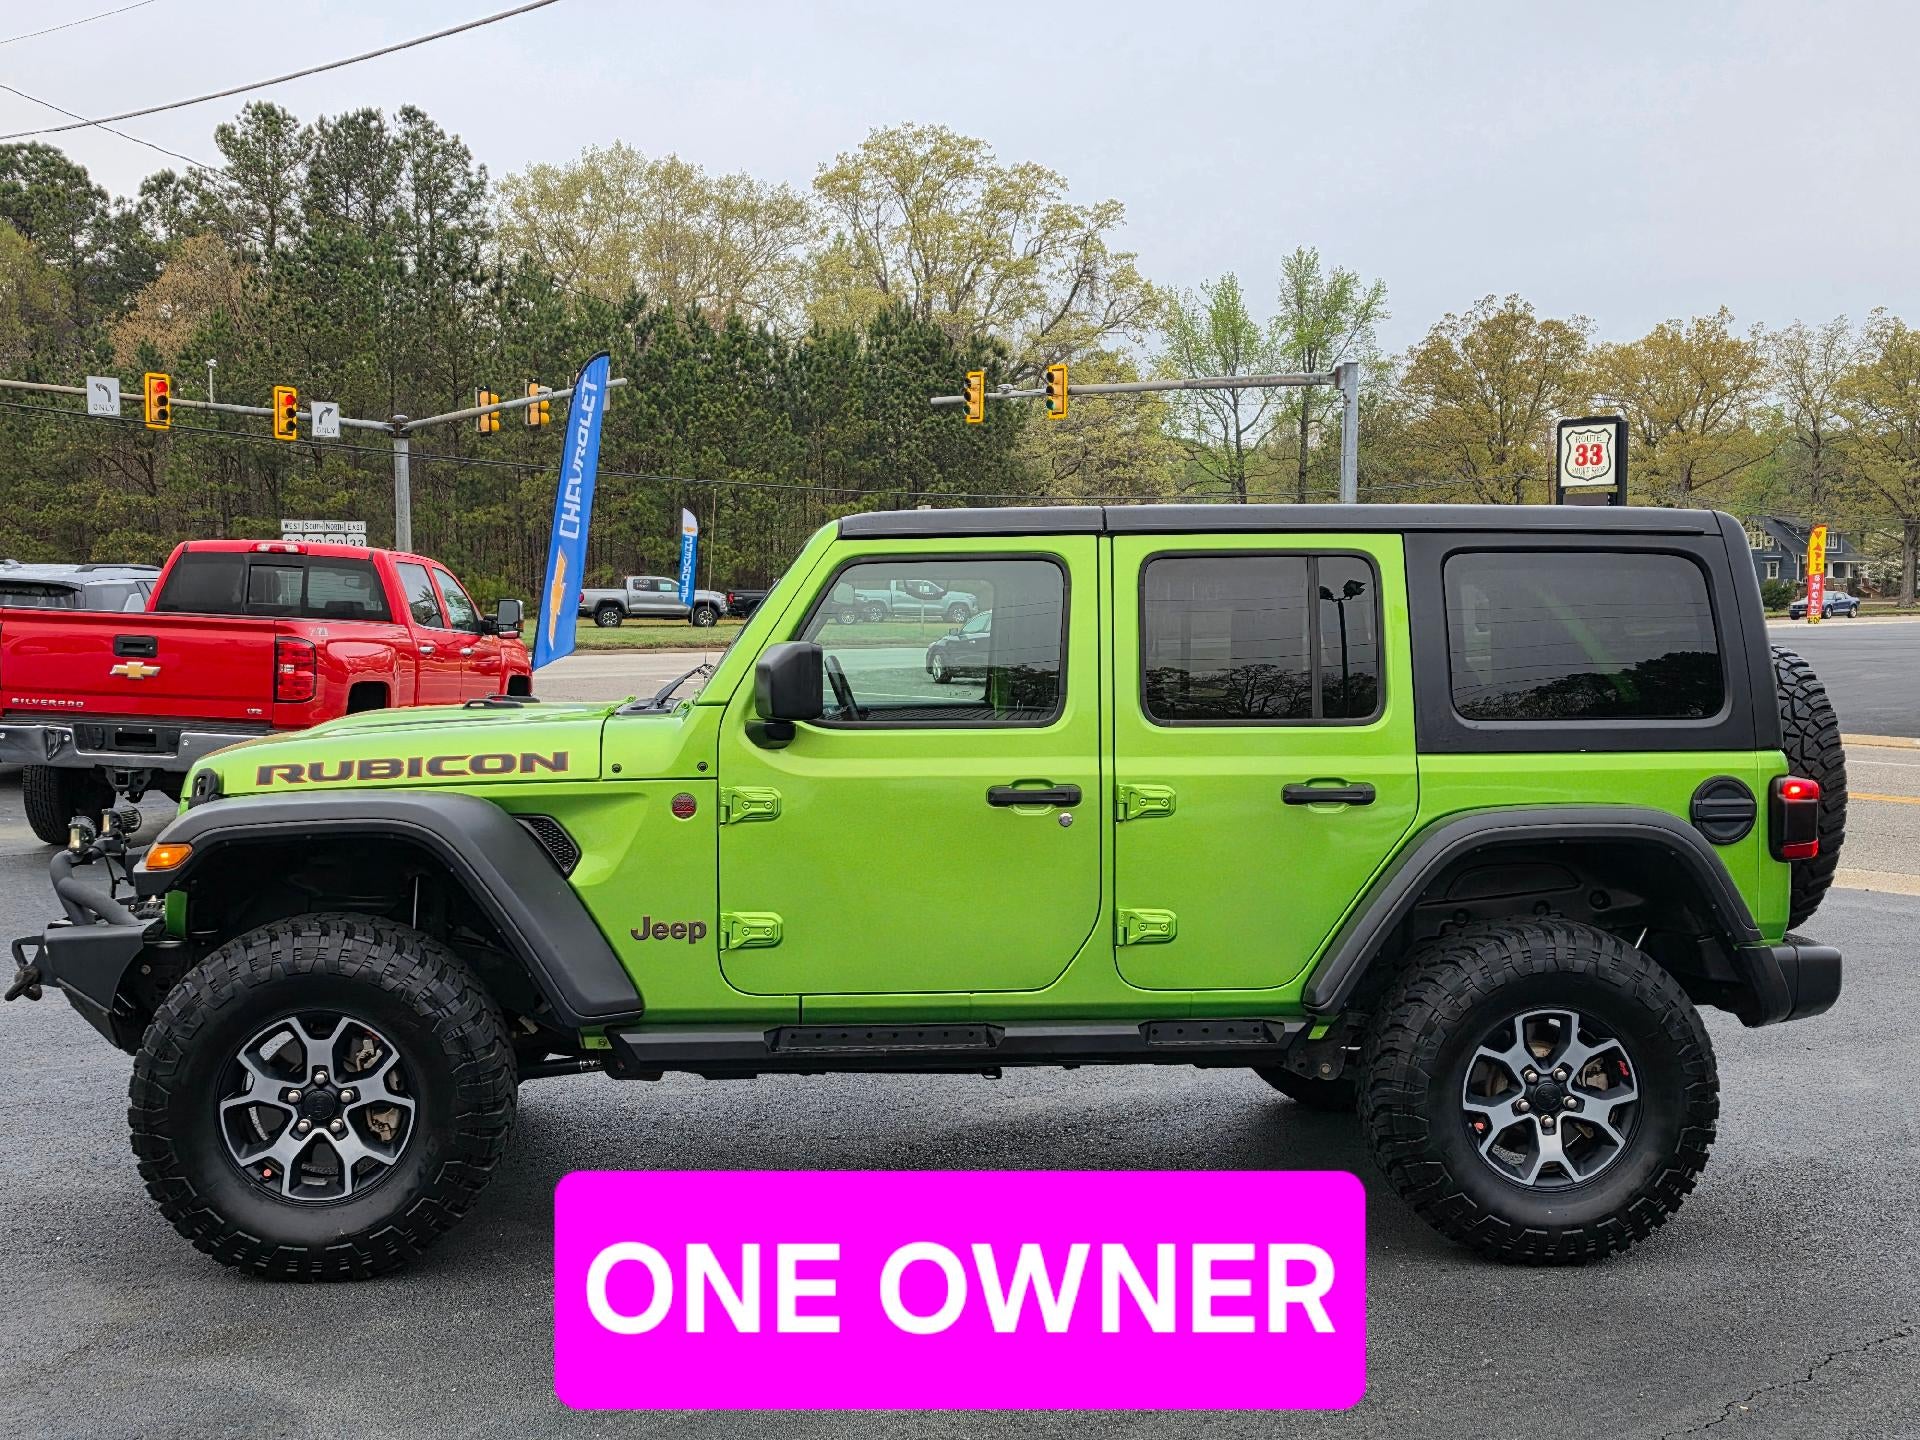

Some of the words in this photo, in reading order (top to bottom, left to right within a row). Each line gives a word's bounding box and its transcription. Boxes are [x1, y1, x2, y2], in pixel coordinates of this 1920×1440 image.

[93, 403, 115, 412] ONLY
[316, 425, 336, 434] ONLY
[1575, 434, 1602, 443] ROUTE
[559, 374, 598, 539] CHEVROLET
[1574, 443, 1604, 467] 33
[284, 522, 300, 530] WEST
[304, 522, 324, 530] SOUTH
[325, 522, 344, 531] NORTH
[347, 523, 363, 531] EAST
[1812, 530, 1823, 572] VAPE
[1810, 574, 1821, 615] SMOKE
[12, 697, 84, 708] SILVERADO
[256, 751, 569, 786] RUBICON
[631, 914, 707, 945] Jeep
